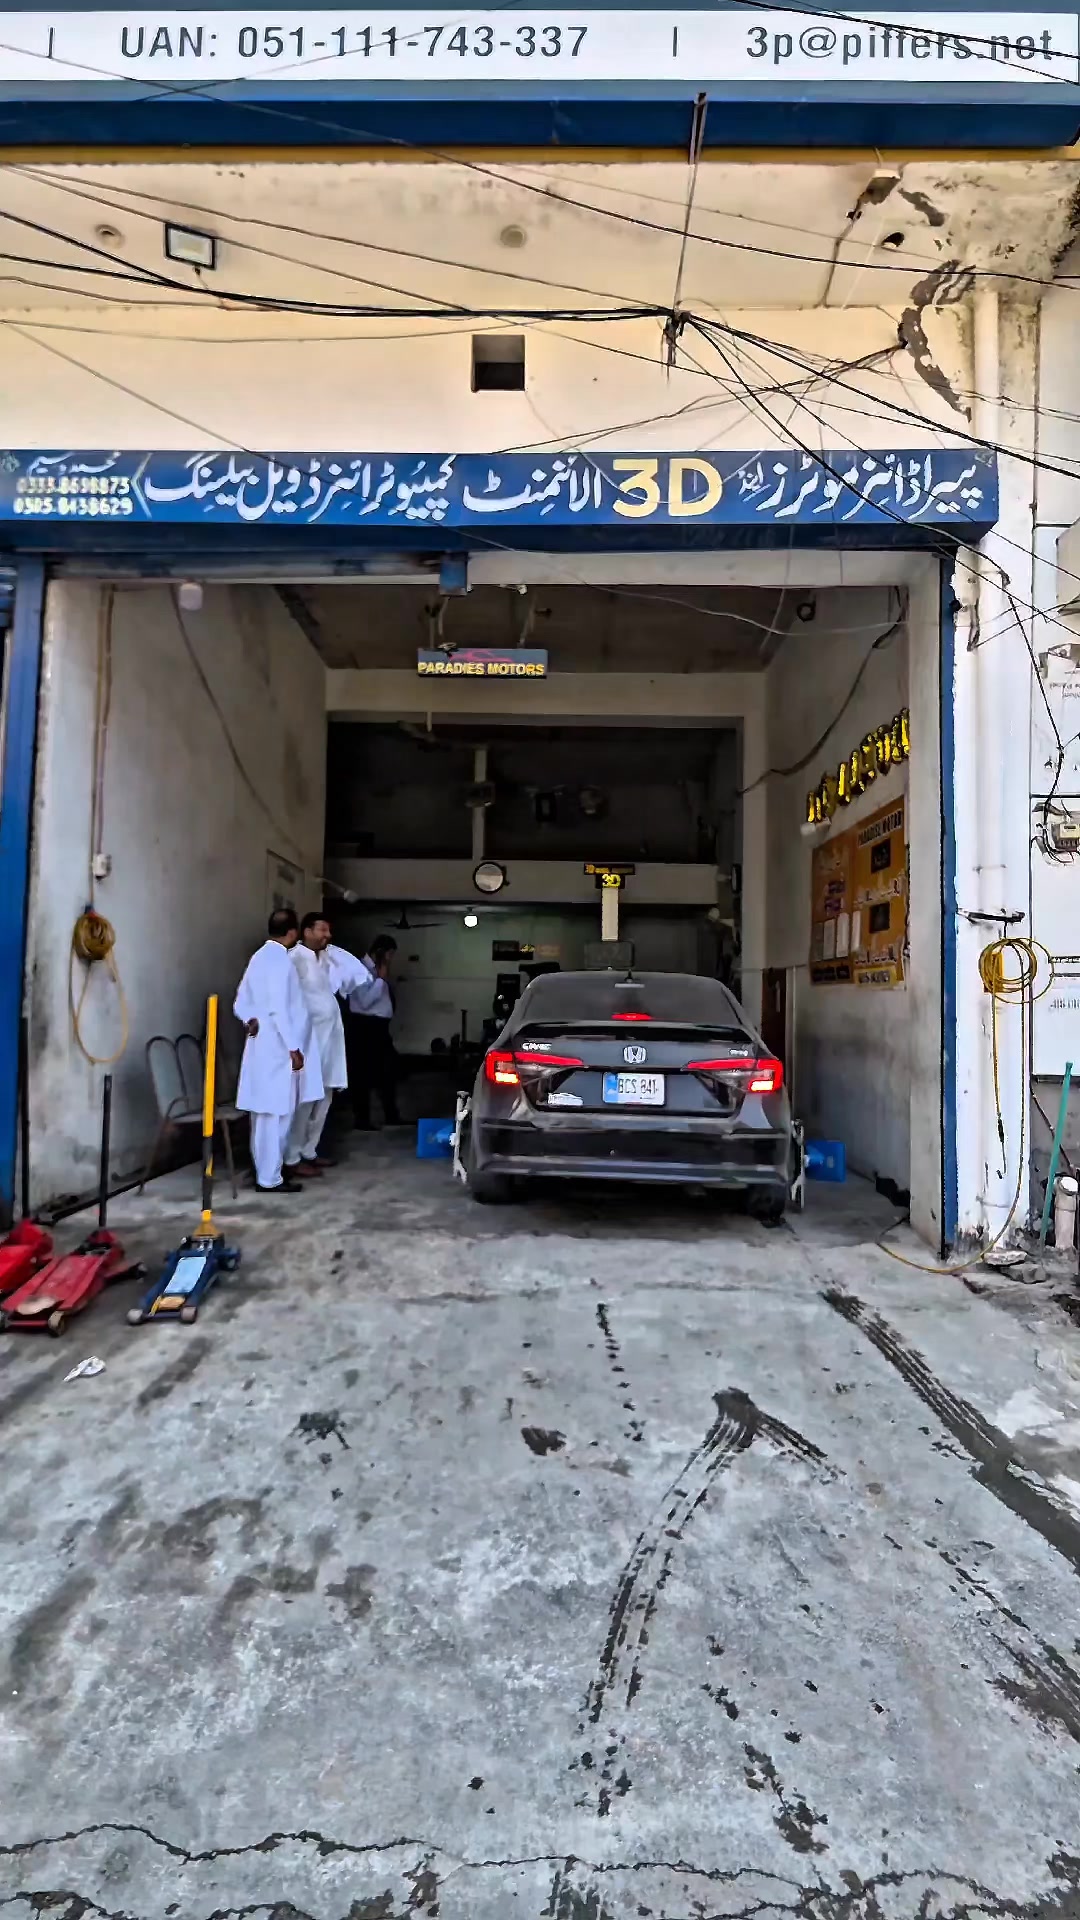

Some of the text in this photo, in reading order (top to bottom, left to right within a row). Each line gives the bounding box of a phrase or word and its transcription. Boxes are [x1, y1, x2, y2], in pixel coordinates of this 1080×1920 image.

[121, 26, 218, 58] UAN:
[239, 26, 588, 58] 051-111-743-337
[612, 457, 723, 518] 3D
[417, 661, 545, 675] PARADIES MOTORS
